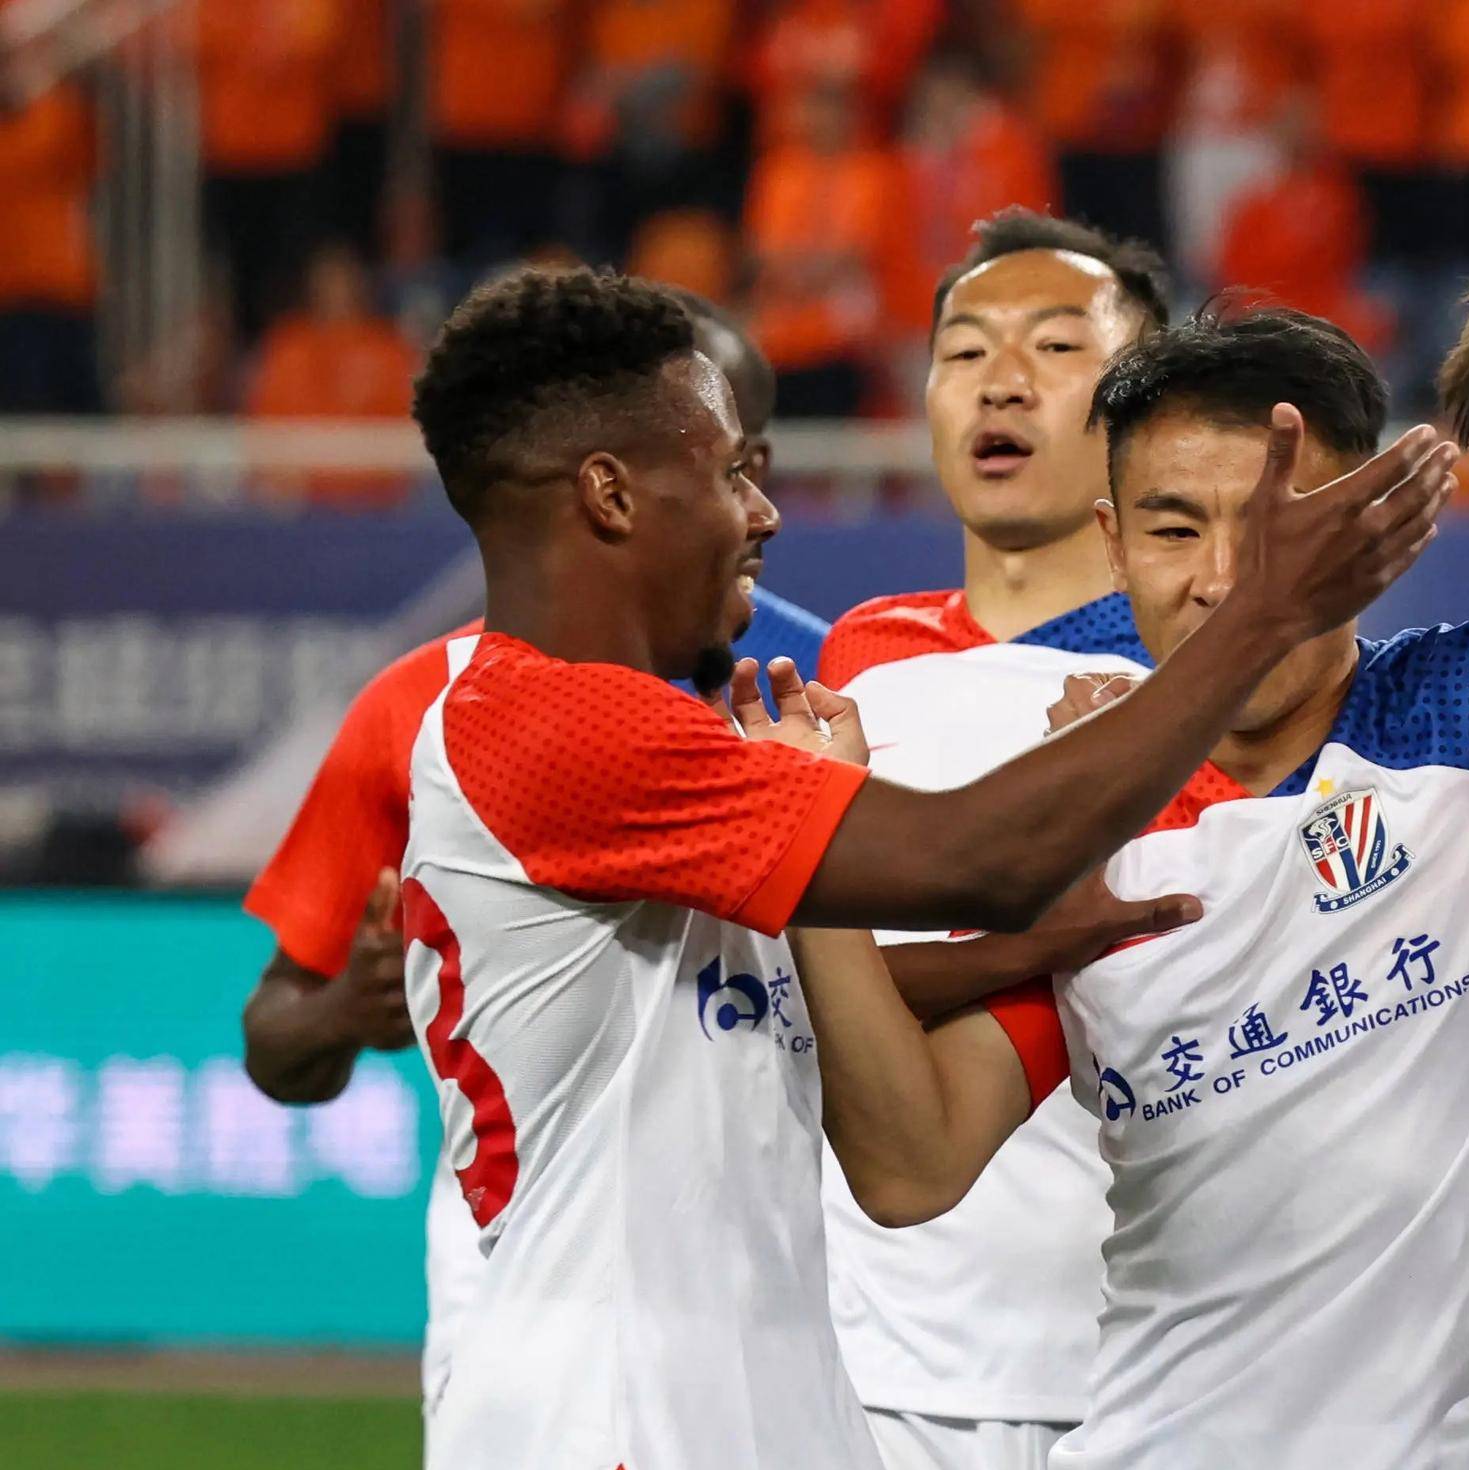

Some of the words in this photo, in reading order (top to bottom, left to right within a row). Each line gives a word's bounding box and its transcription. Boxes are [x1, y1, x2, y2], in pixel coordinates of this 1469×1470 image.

[1311, 836, 1349, 860] SFC
[1343, 877, 1387, 905] SHANGHAI
[1162, 933, 1441, 1093] 交通銀行
[791, 1035, 814, 1053] OF
[1142, 1088, 1203, 1122] BANK
[1213, 1069, 1247, 1095] OF
